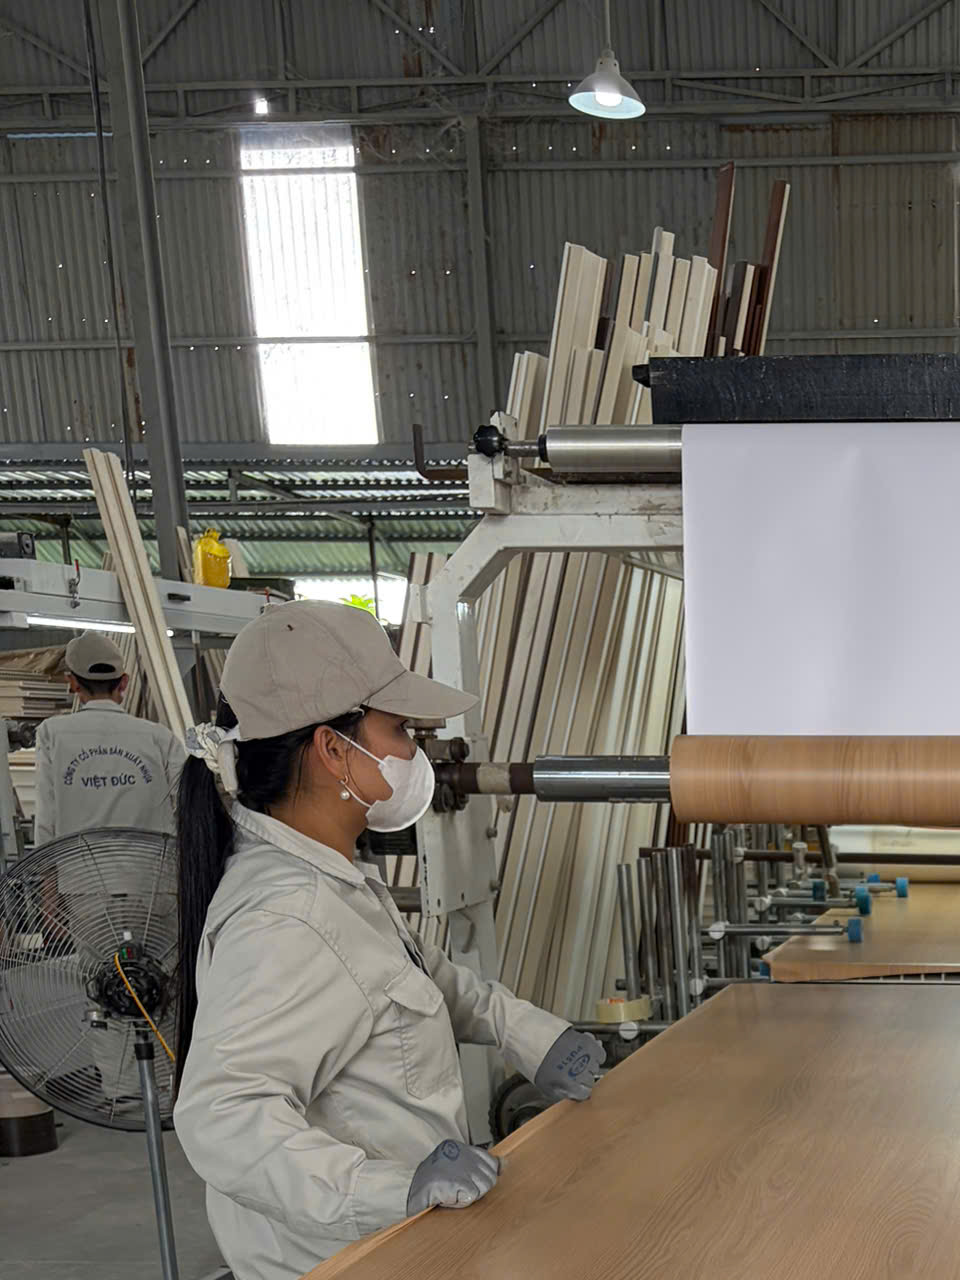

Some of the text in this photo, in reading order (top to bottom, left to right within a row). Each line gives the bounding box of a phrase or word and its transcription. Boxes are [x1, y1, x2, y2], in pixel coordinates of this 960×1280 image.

[70, 758, 80, 767] TY
[81, 772, 136, 790] VIỆT ĐỨC
